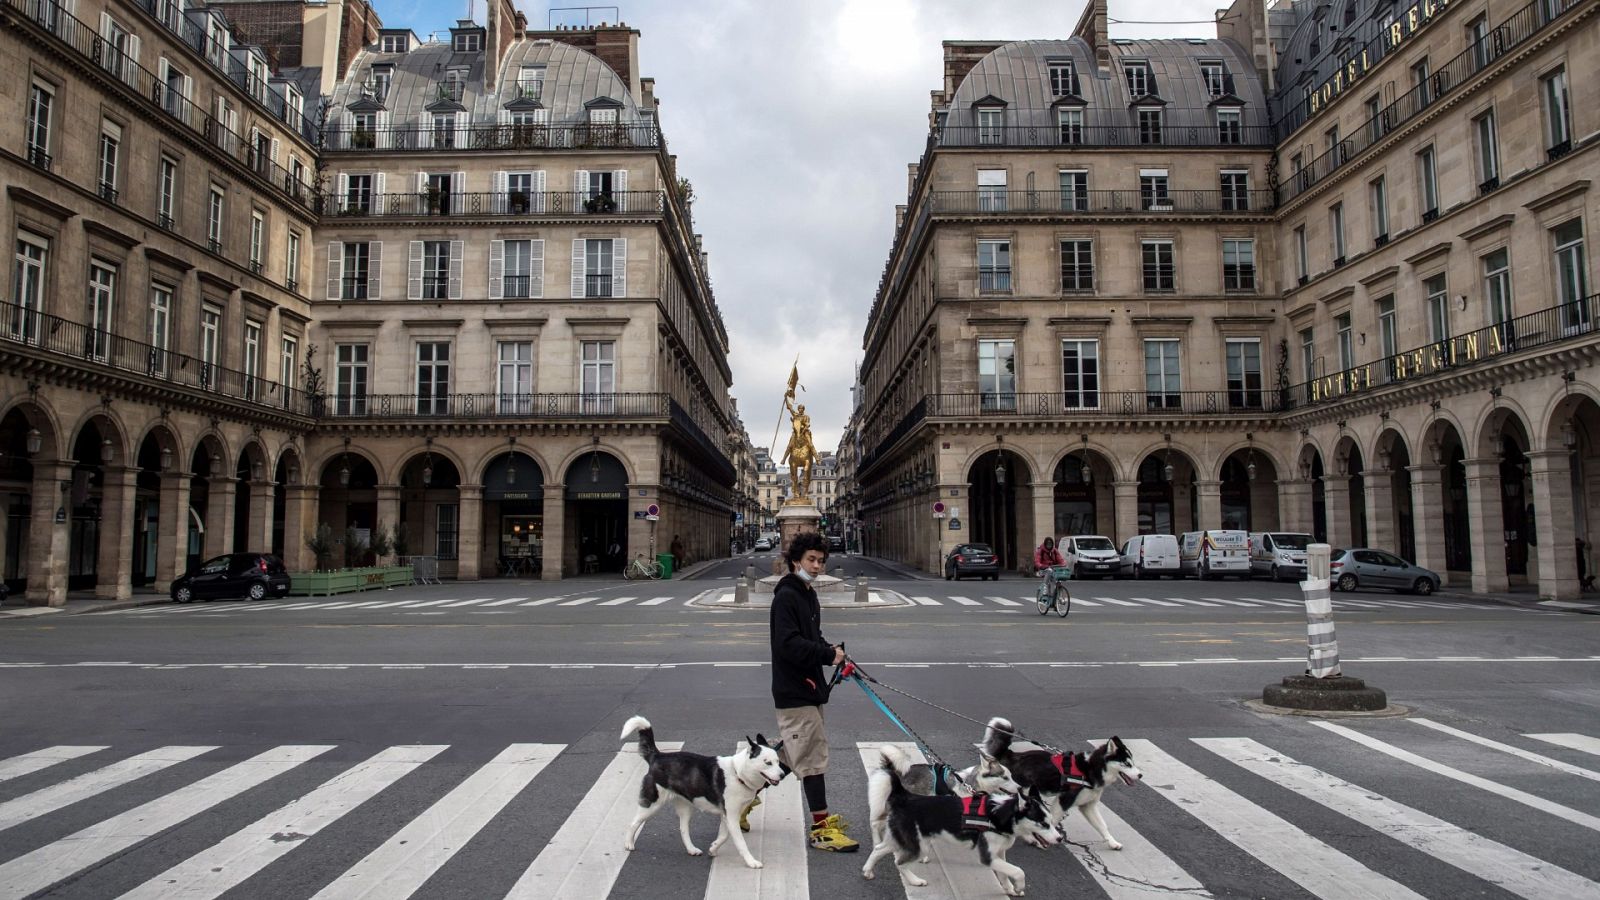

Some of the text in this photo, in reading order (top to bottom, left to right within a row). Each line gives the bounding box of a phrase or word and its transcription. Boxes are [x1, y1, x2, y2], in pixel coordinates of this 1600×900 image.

[1312, 0, 1450, 113] HOTEL REG
[1312, 326, 1502, 401] HOTEL REGINA
